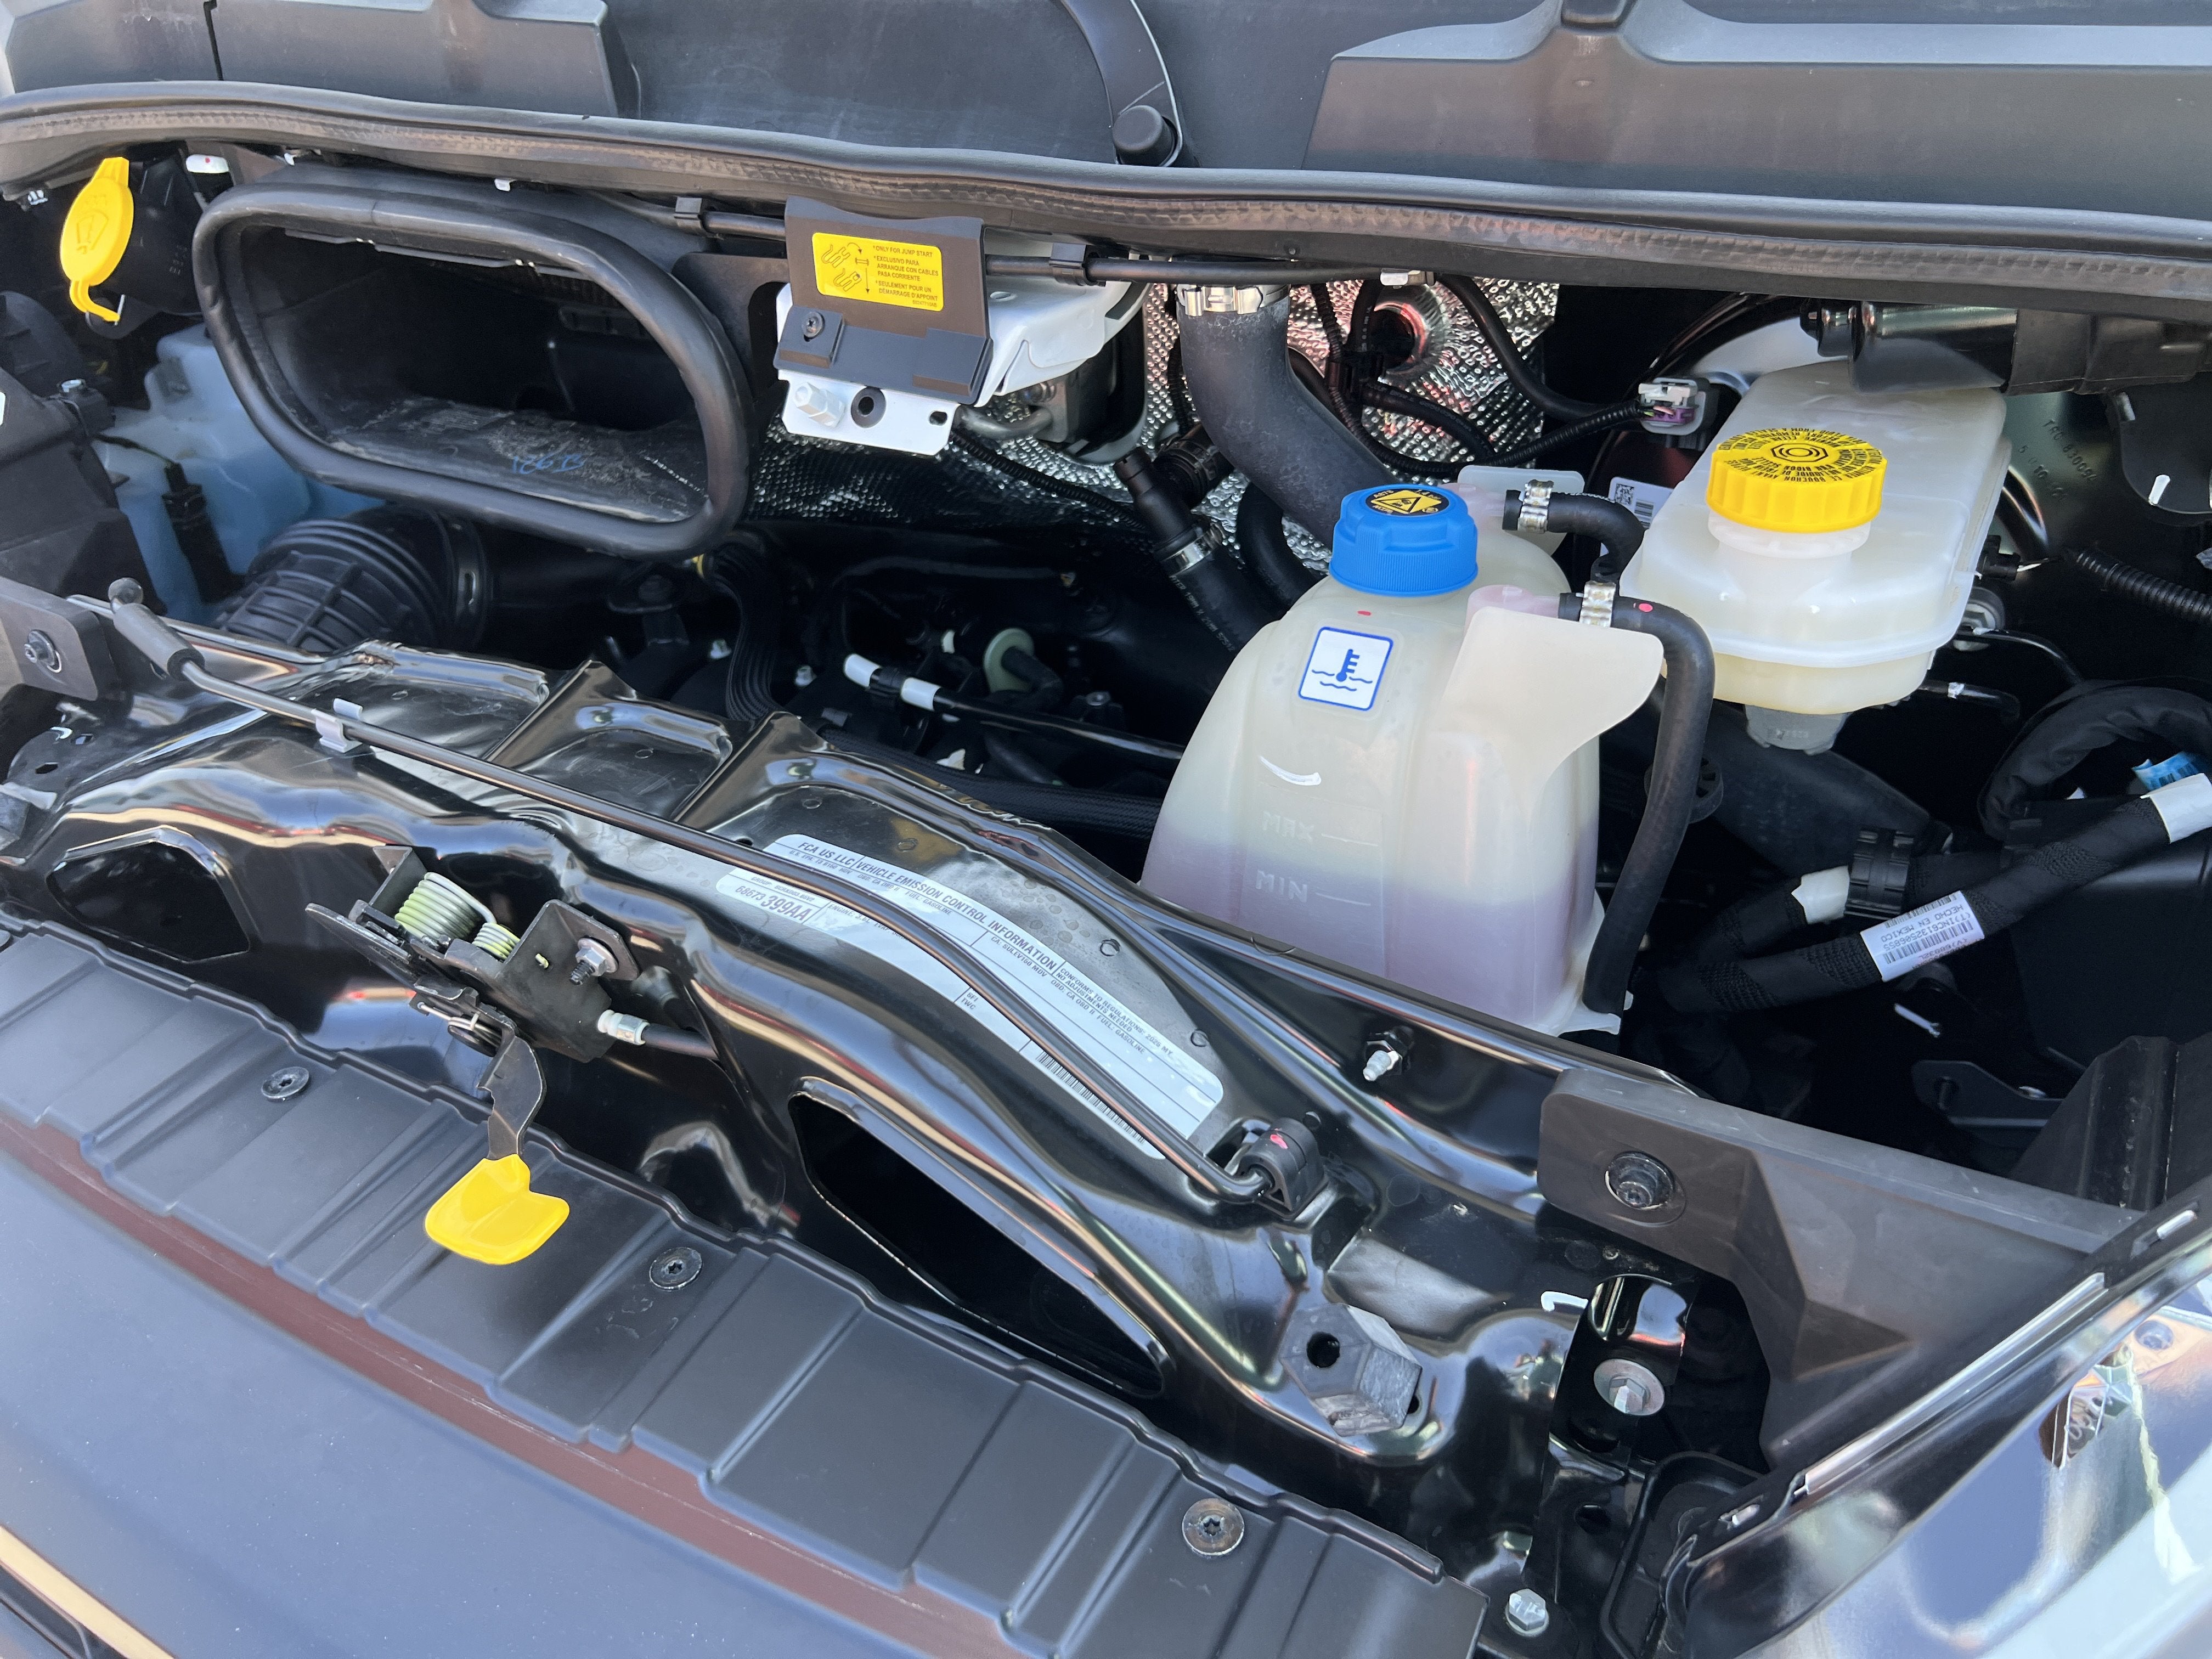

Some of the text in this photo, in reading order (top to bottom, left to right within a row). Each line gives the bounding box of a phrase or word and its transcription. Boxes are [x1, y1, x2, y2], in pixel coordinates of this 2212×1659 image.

[877, 263, 905, 272] ARRANQUE
[891, 273, 921, 281] CORRIENTE
[1263, 811, 1314, 842] MAX
[1255, 869, 1308, 903] MIN
[906, 891, 953, 916] FUEL: GASOLINE
[1881, 905, 1965, 943] HECHO EN MEXICO
[798, 843, 819, 853] FCA
[819, 849, 835, 858] US
[834, 855, 855, 865] LLC
[856, 861, 897, 879] VEHICLE
[895, 875, 944, 899] EMISSION
[942, 895, 988, 924] CONTROL
[988, 920, 1057, 970] INFORMATION
[1060, 968, 1093, 994] CONFORMS
[1094, 994, 1103, 1002] TO
[1161, 1045, 1173, 1056] MY
[991, 936, 1001, 945] CA:
[1031, 964, 1047, 977] MDV
[961, 997, 976, 1010] TWC
[1056, 972, 1132, 1032] NO ADJUSTMENTS NEEDED
[1066, 991, 1075, 1000] CA
[1076, 998, 1089, 1010] OBD
[1097, 1014, 1146, 1054] FUEL: GASOLINE
